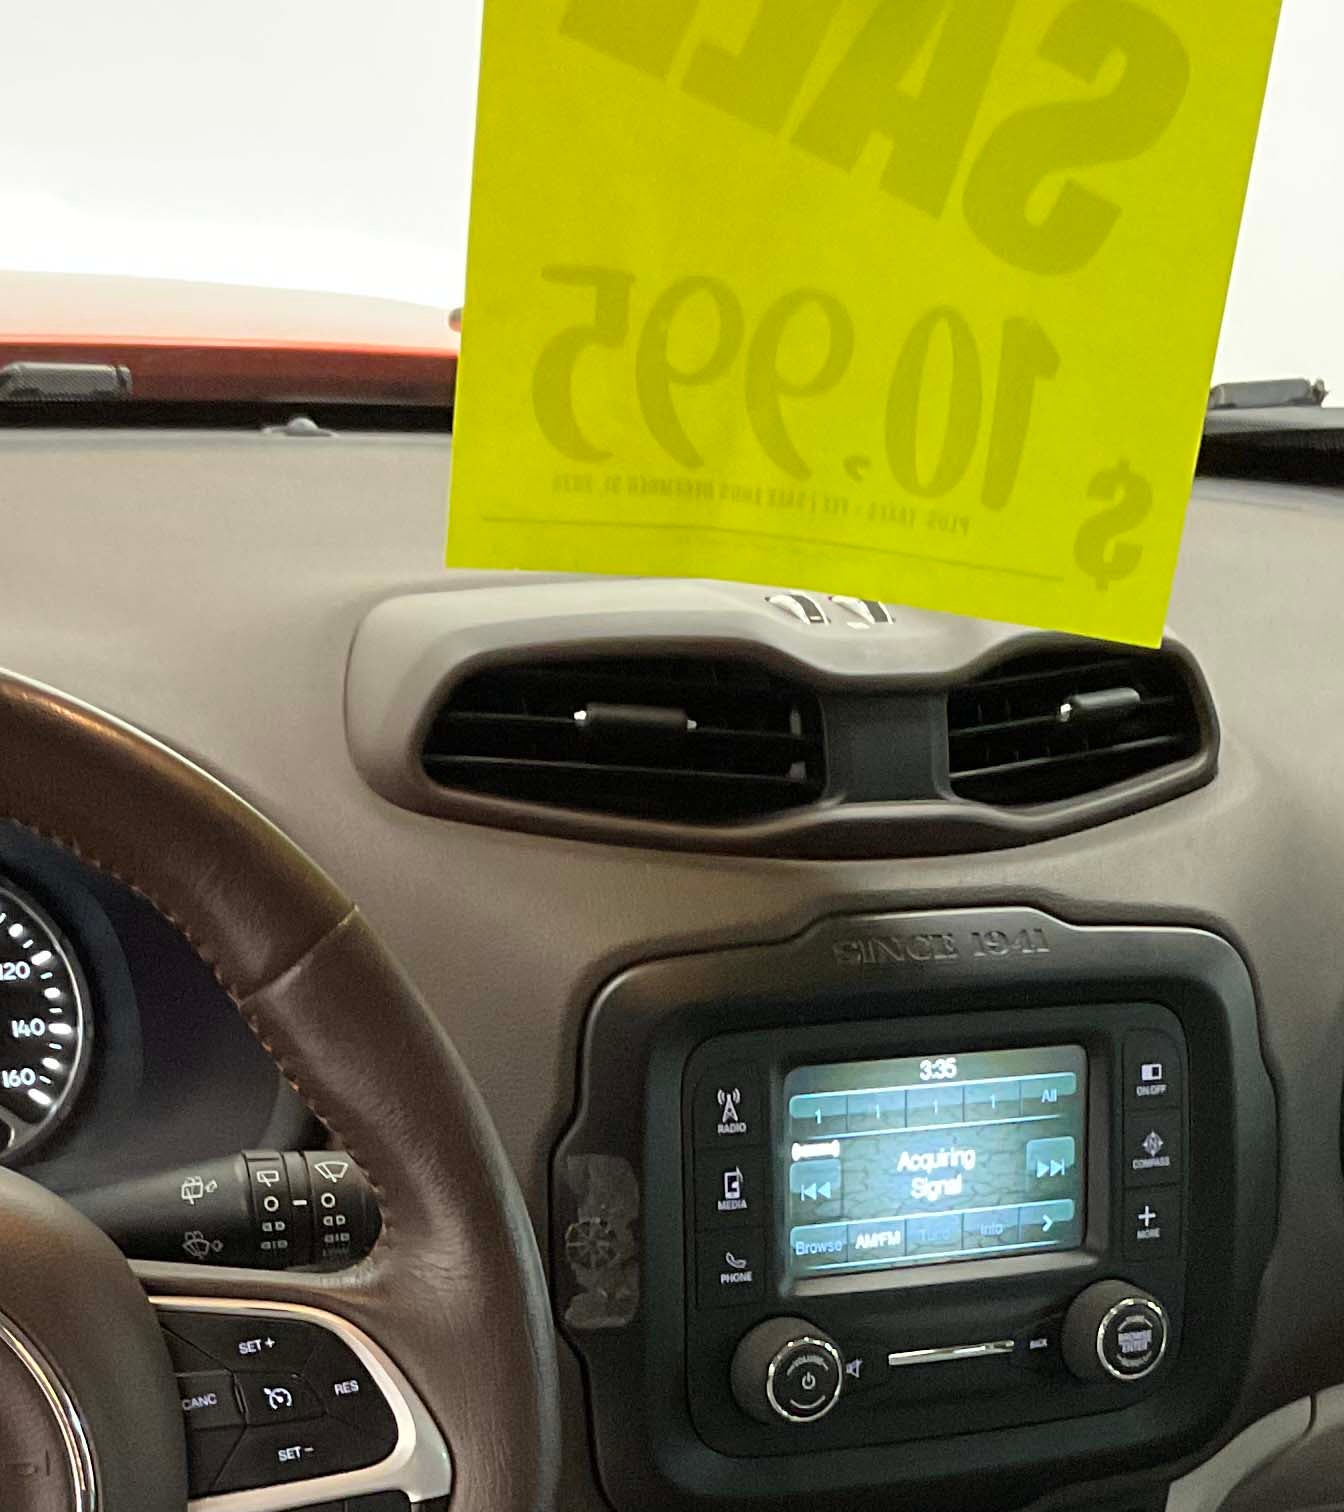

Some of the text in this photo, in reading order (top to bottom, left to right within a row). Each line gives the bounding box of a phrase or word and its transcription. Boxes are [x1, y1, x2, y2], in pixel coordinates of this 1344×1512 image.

[833, 927, 1051, 963] SINCE 1941
[11, 1018, 45, 1038] 140
[2, 1069, 35, 1088] 160
[717, 1122, 747, 1135] RADIO
[896, 1147, 976, 1174] Acquiring
[910, 1174, 963, 1202] Signal
[717, 1200, 748, 1212] MEDIA
[720, 1271, 752, 1285] PHONE
[239, 1339, 262, 1355] SET
[334, 1380, 359, 1395] RES
[182, 1393, 217, 1411] CANC
[278, 1446, 301, 1462] SET
